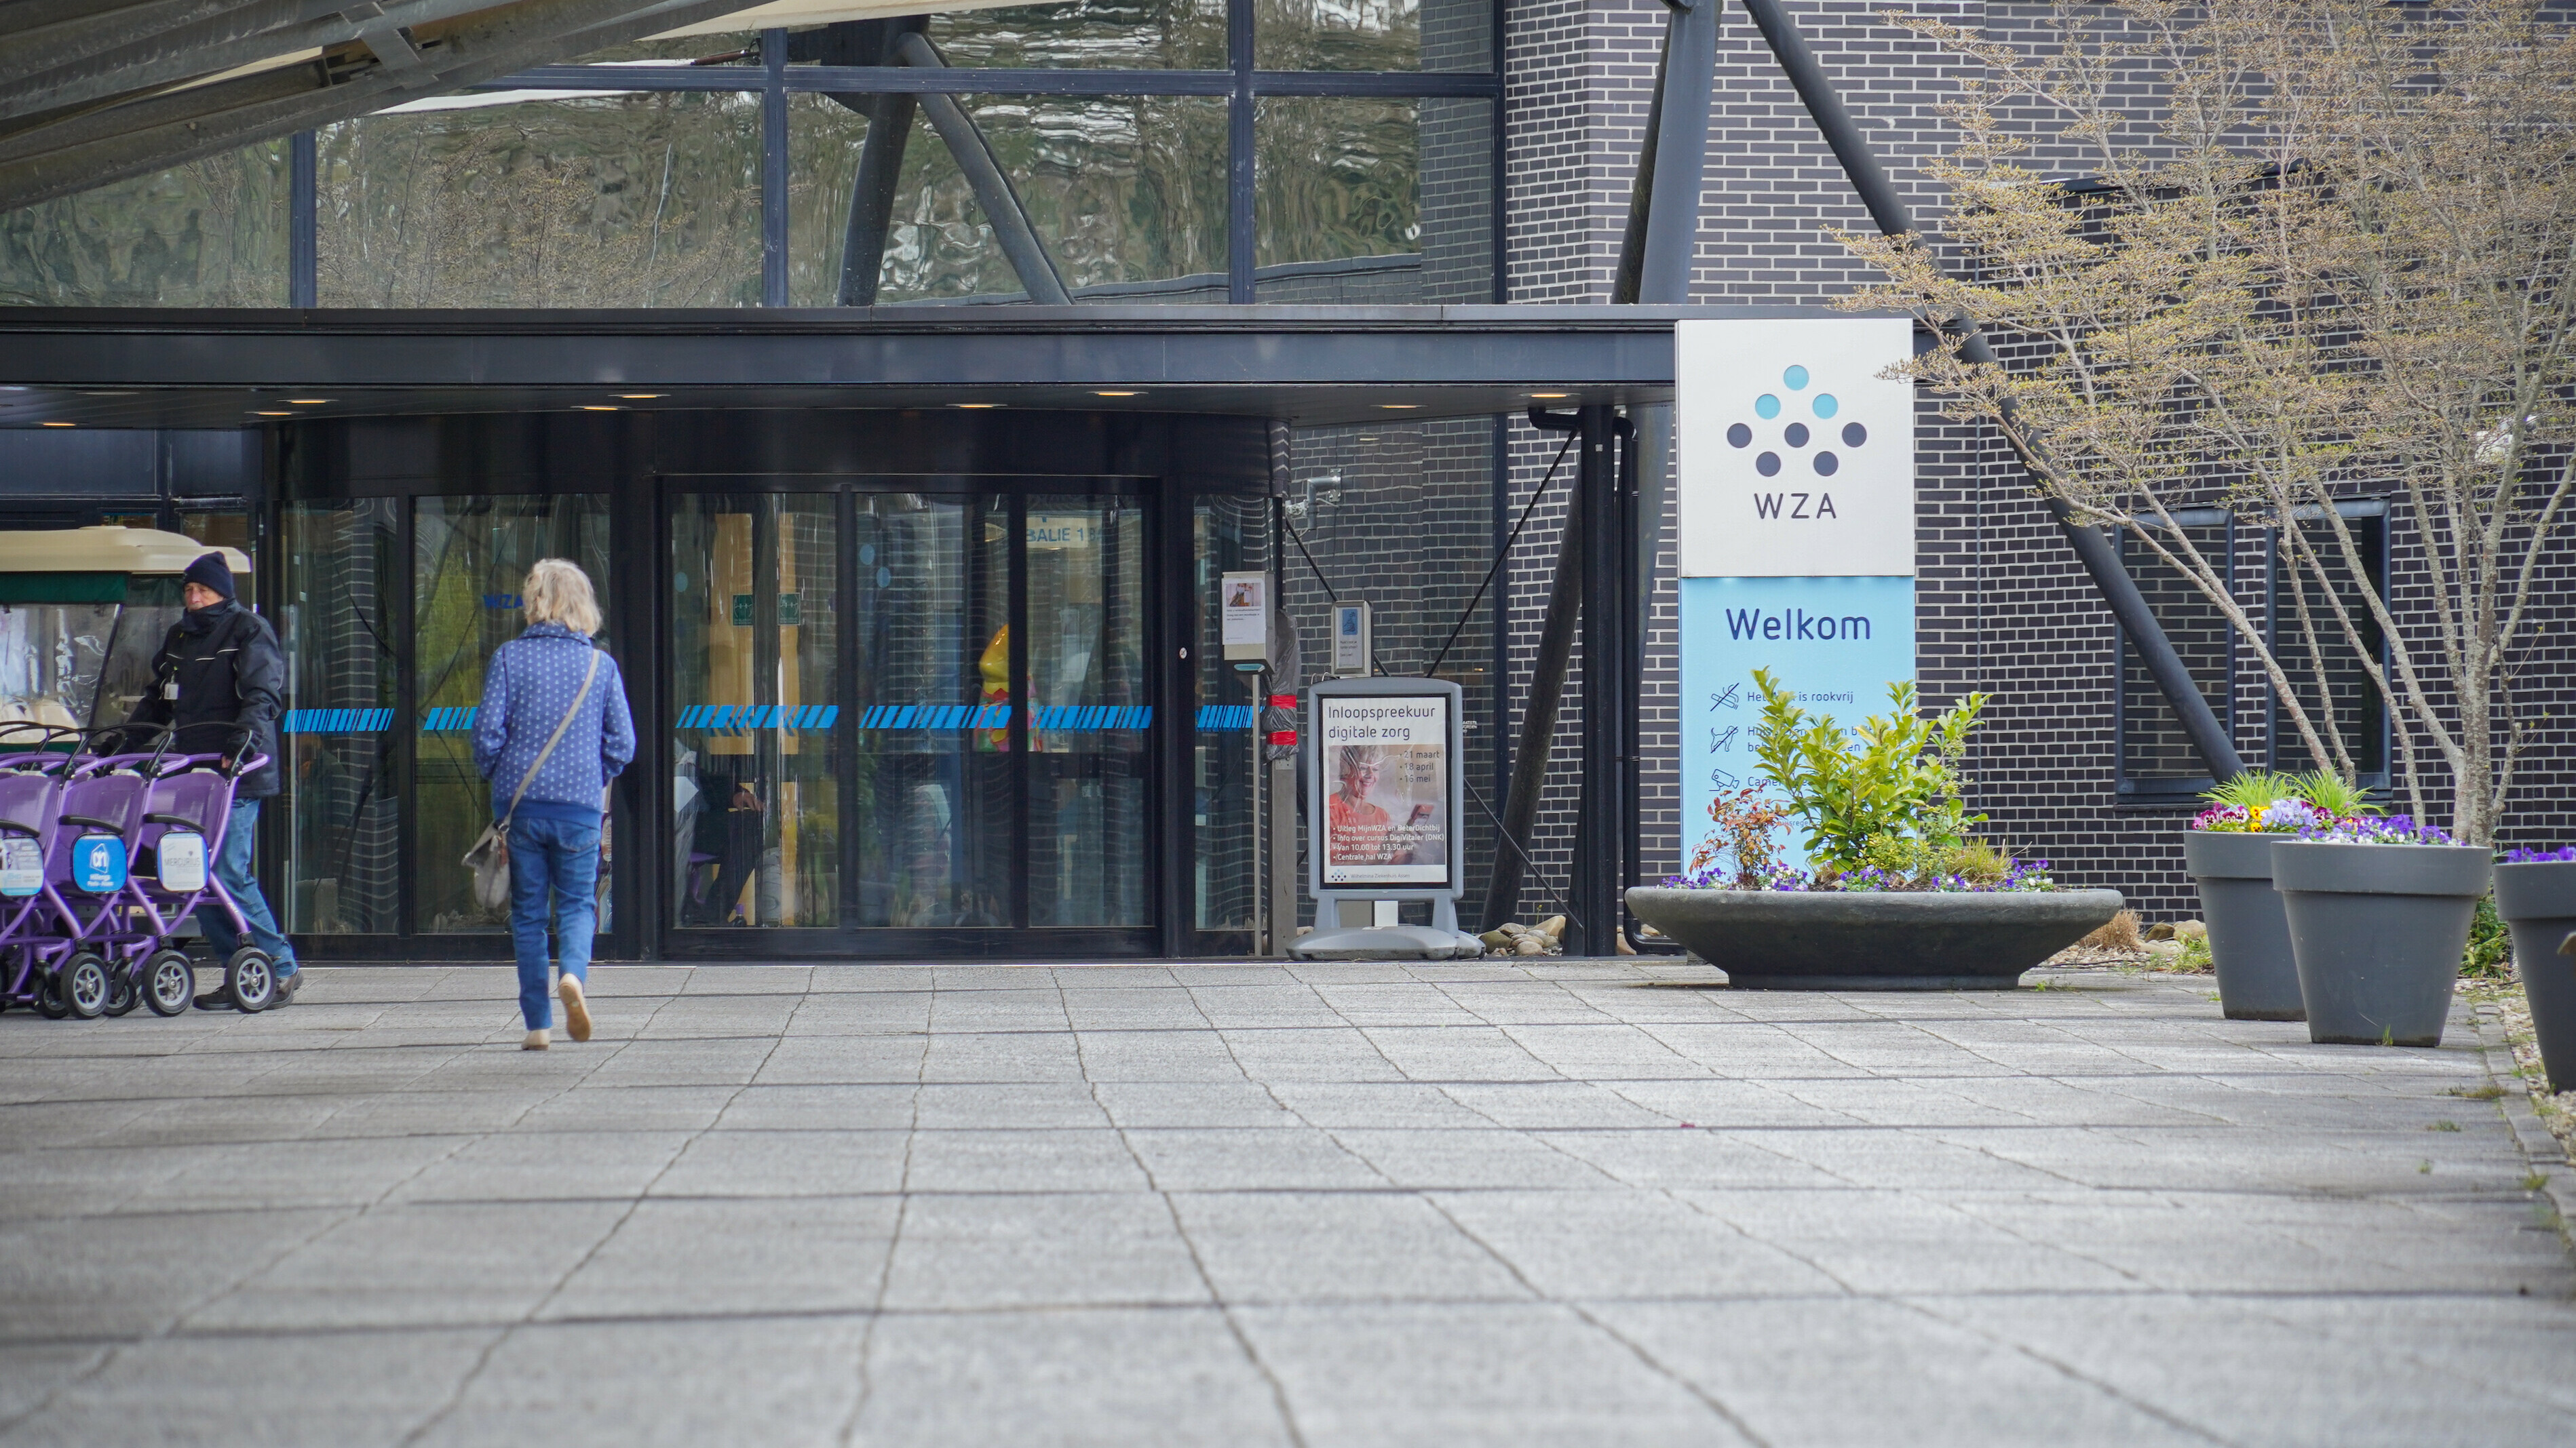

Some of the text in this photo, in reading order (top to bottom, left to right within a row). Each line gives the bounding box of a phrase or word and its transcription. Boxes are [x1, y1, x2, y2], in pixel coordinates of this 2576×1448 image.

[1754, 492, 1837, 520] WZA
[1077, 529, 1084, 541] 1
[1726, 608, 1870, 640] Welkom
[1799, 692, 1807, 701] is
[1811, 692, 1853, 704] rookvrij
[1328, 705, 1436, 721] Inloopspreekuur
[1328, 726, 1410, 741] digitale zorg
[1404, 750, 1412, 758] 21
[1404, 762, 1433, 772] 18 april
[1404, 775, 1431, 783] 16 mei
[1358, 825, 1386, 833] MijnWZA
[1398, 825, 1440, 833] BeterDichtbij
[1389, 834, 1423, 842] DigiVitaler
[1425, 834, 1444, 842] (DNK)
